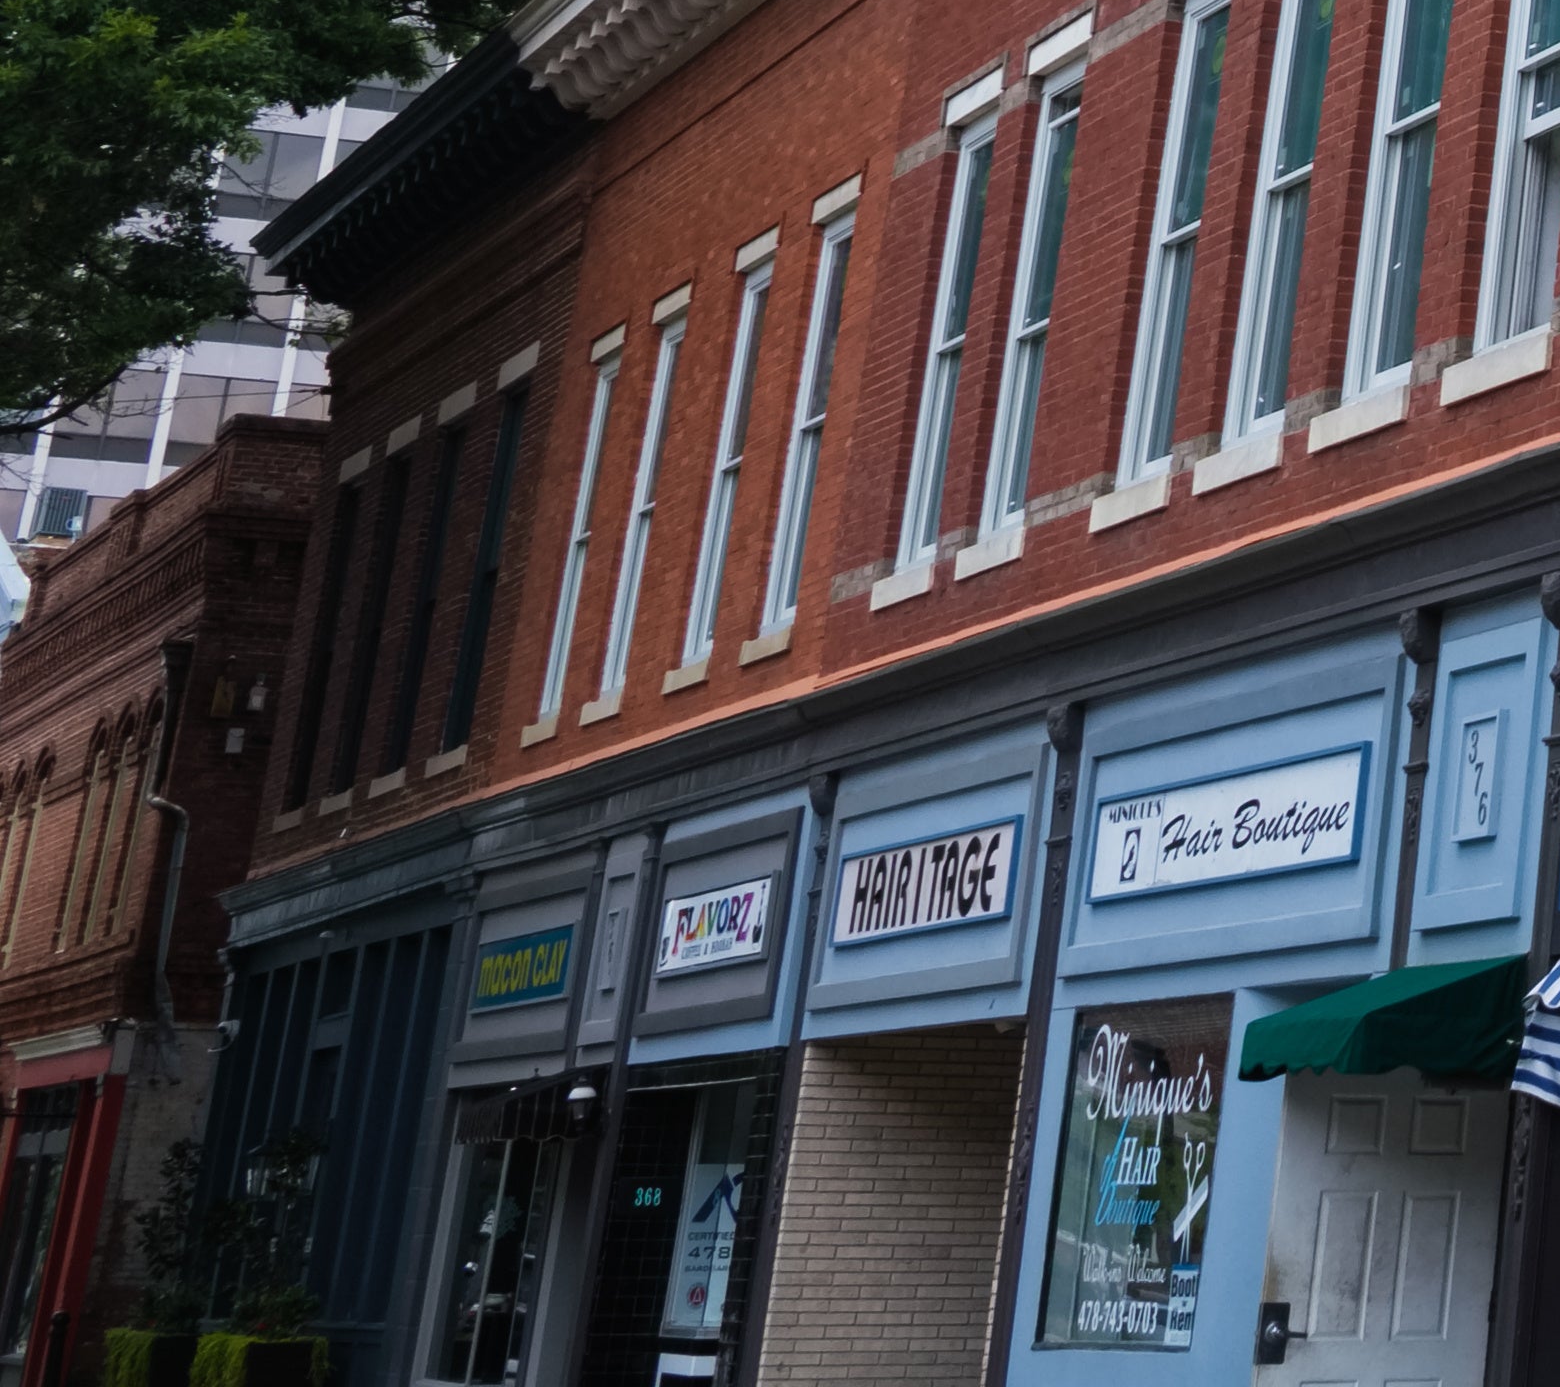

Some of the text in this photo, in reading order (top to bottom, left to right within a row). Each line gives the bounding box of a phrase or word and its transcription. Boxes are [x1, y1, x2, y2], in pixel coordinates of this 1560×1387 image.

[1161, 798, 1350, 863] Hair Boutique
[671, 892, 754, 955] FLAVORZ
[532, 938, 568, 988] CLAY
[1086, 1024, 1213, 1146] Minique's
[634, 1186, 662, 1207] 368
[1078, 1299, 1158, 1334] 478-743-0703
